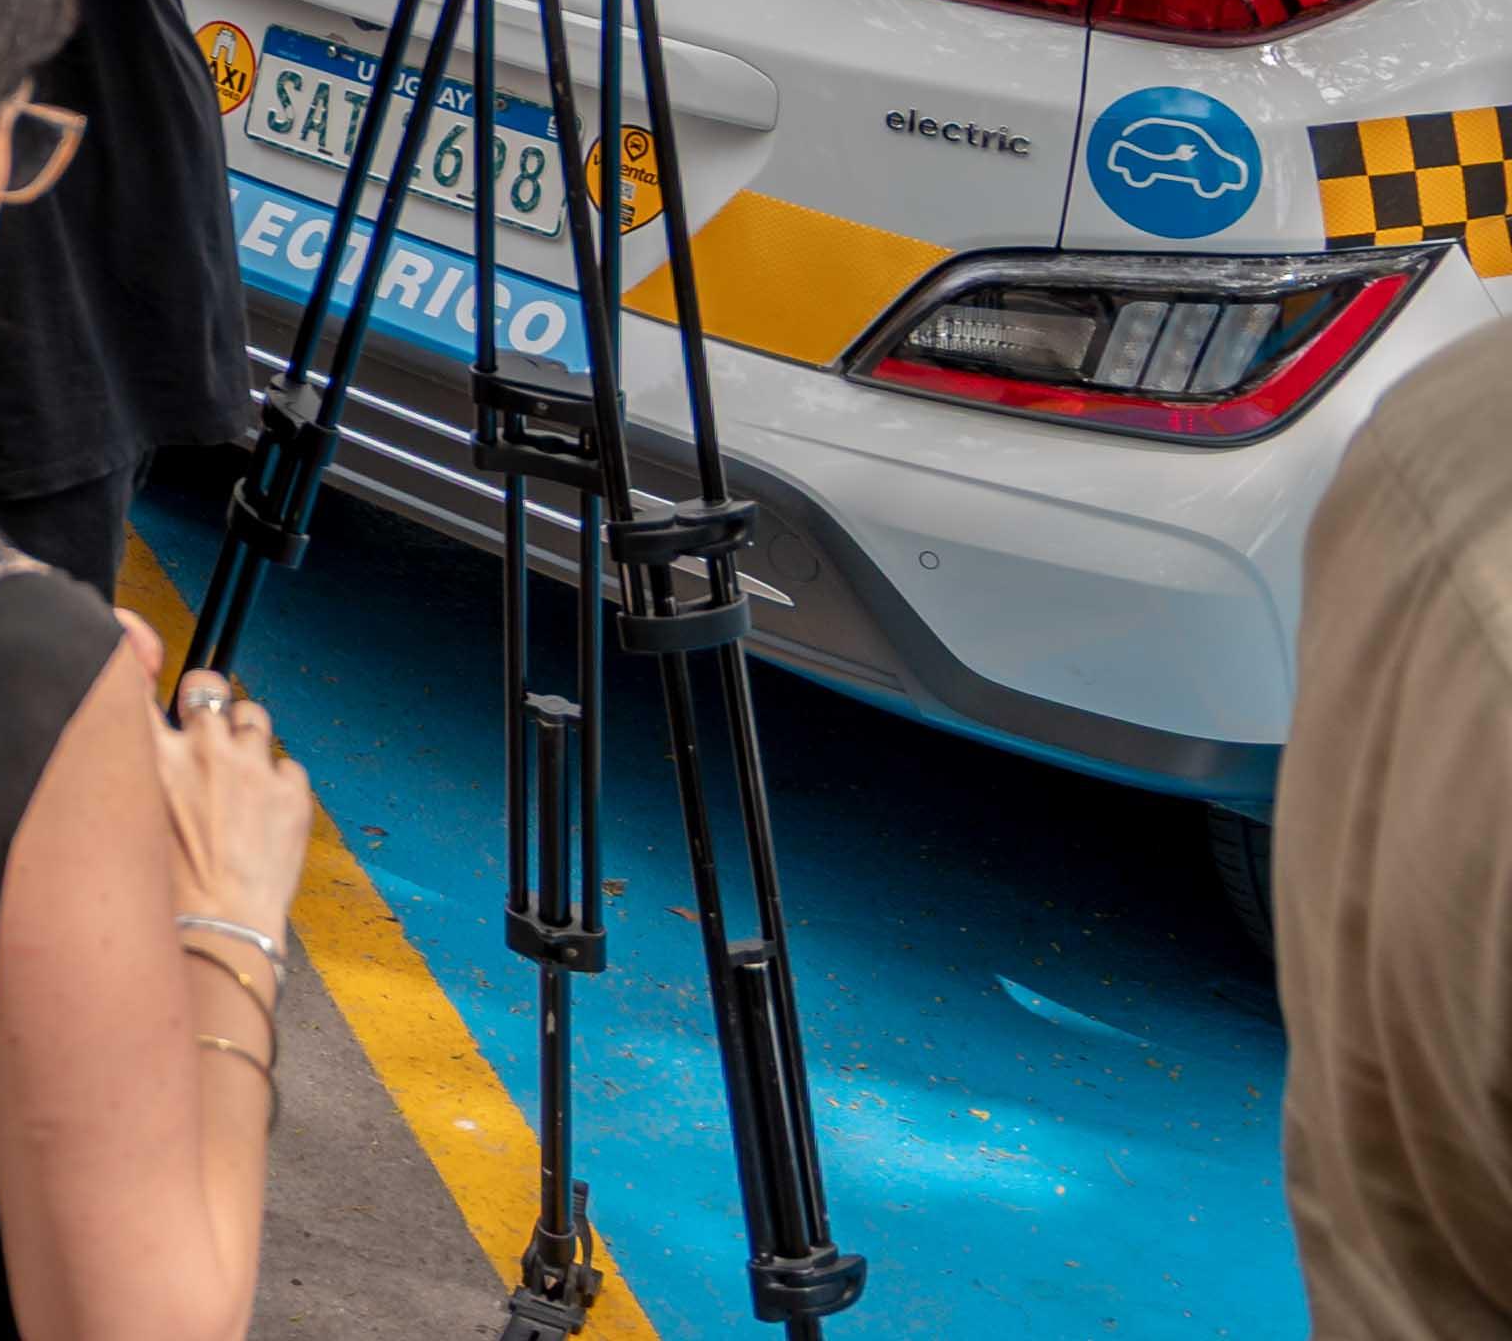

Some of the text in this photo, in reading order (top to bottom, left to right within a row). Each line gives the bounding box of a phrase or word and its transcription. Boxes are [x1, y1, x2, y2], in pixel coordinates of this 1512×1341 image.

[267, 70, 370, 156] SAT
[886, 107, 1032, 154] electric
[228, 189, 567, 355] ECTRICO
